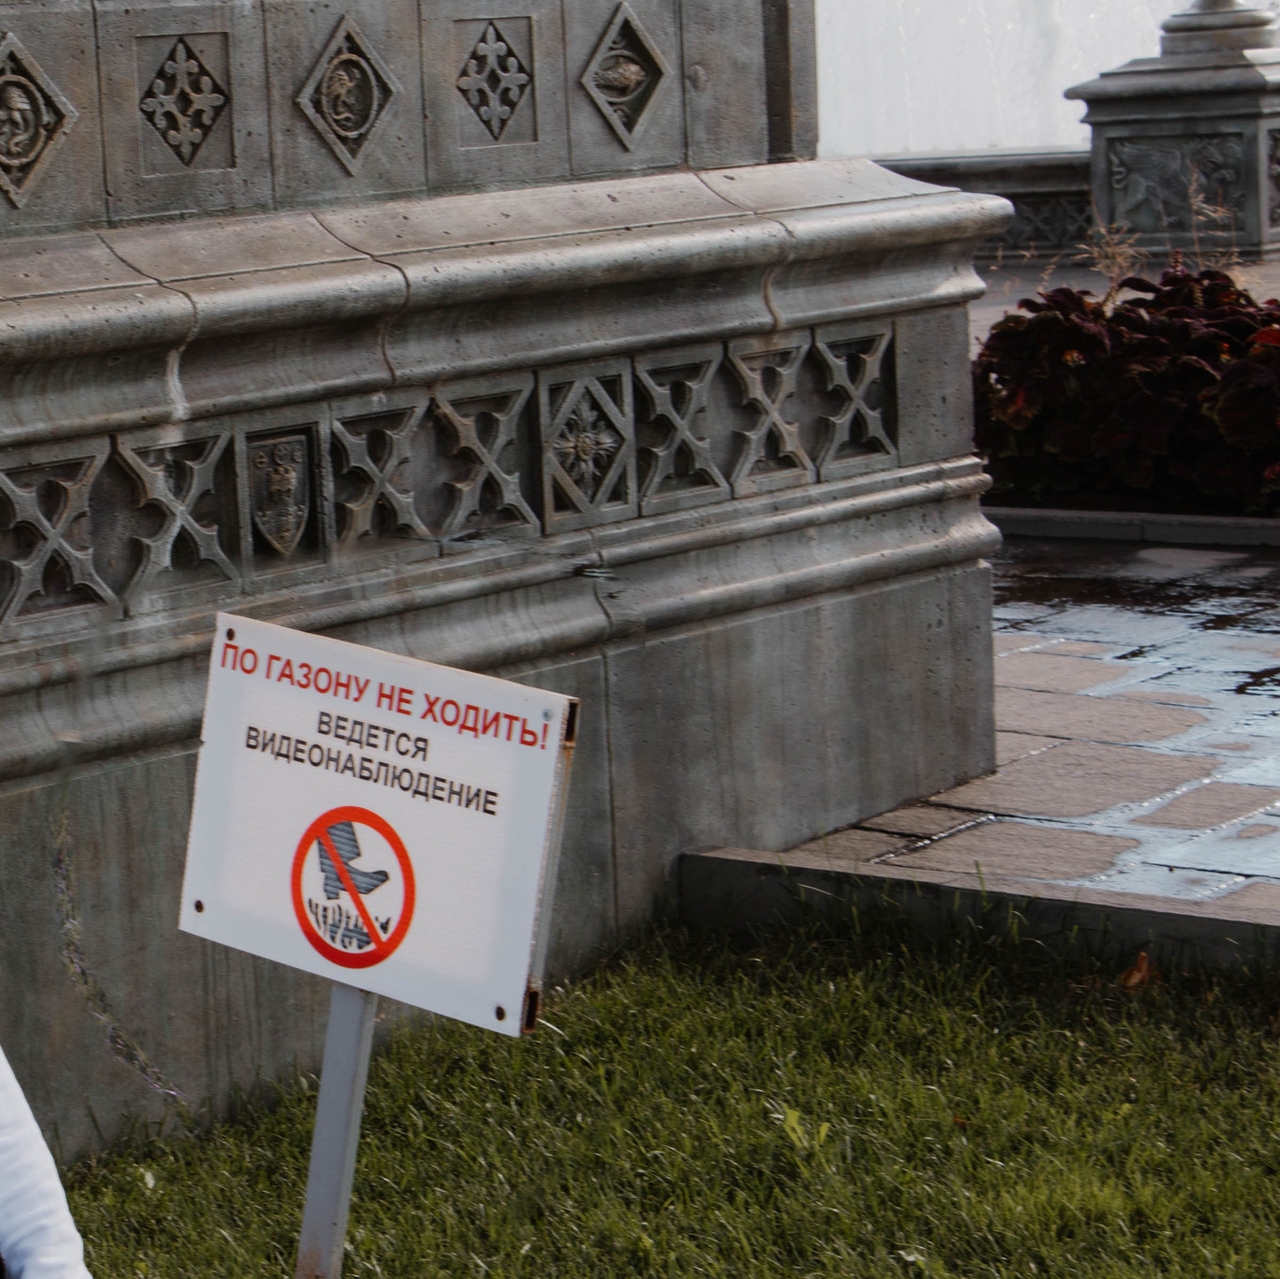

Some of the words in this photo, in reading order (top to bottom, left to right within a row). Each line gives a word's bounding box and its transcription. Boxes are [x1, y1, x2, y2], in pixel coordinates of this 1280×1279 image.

[221, 642, 259, 675] ПО
[265, 654, 370, 703] ГАЗОНУ
[376, 682, 414, 716] НЕ
[421, 693, 549, 750] ХОДИТЬ!
[317, 710, 429, 761] ВЕДЕТСЯ
[245, 725, 499, 816] ВИДЕОНАБЛЮДЕНИЕ
